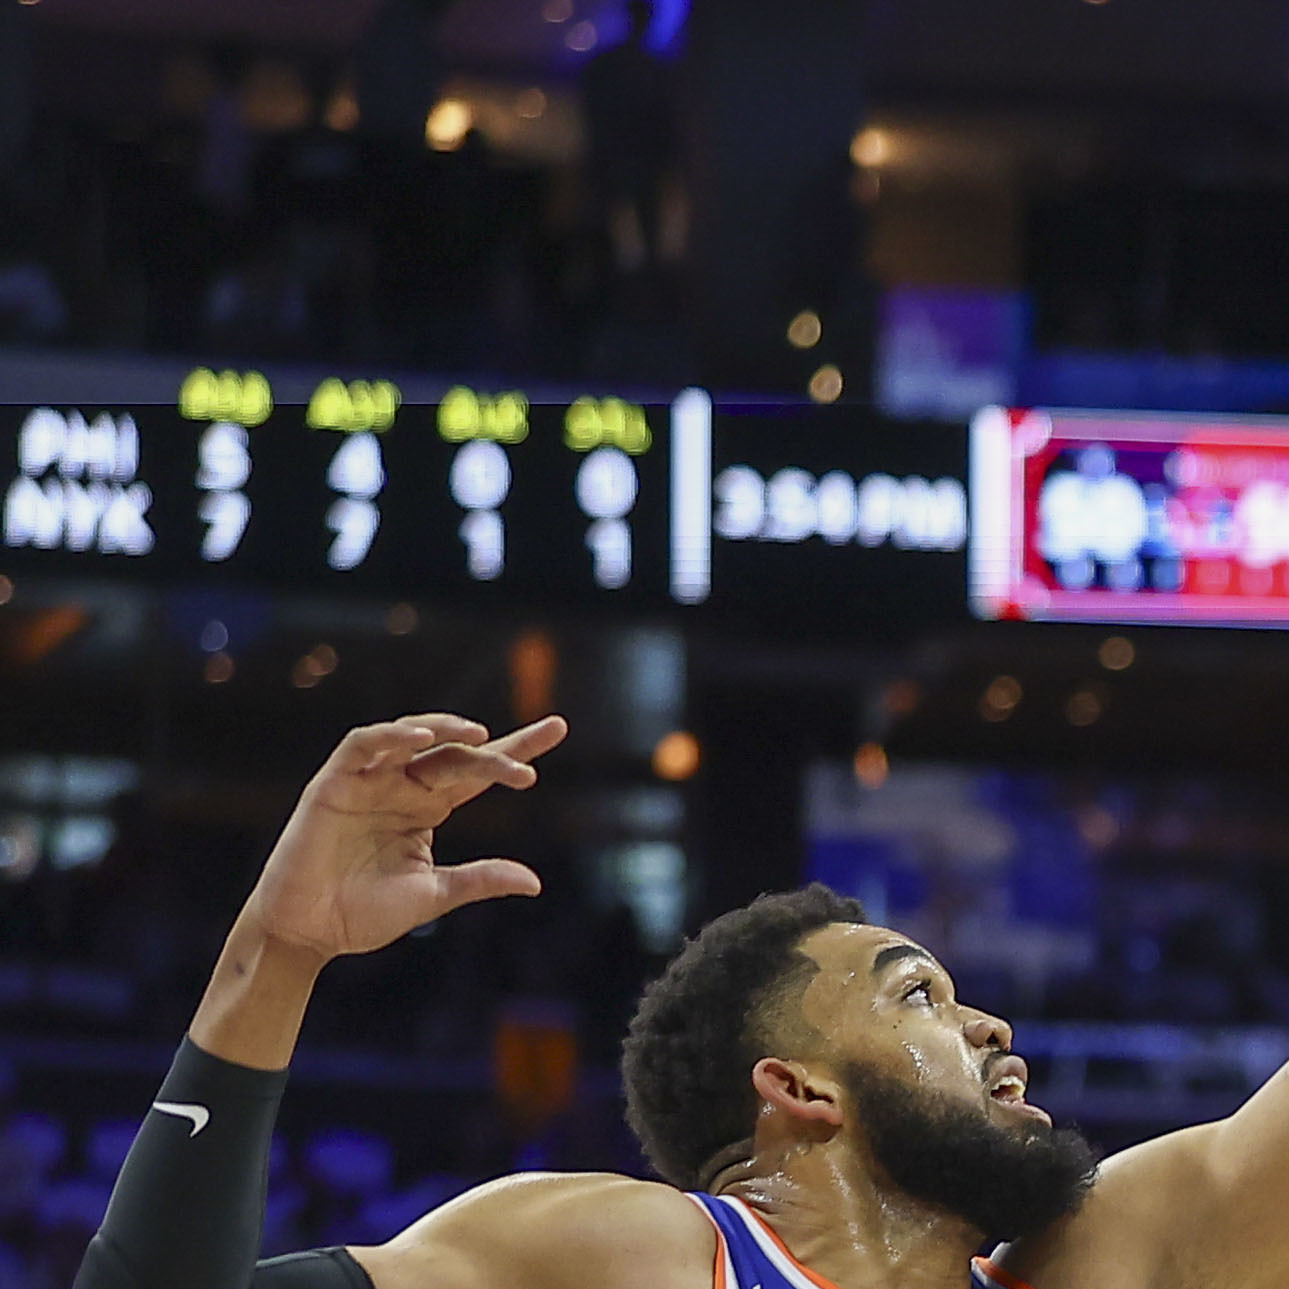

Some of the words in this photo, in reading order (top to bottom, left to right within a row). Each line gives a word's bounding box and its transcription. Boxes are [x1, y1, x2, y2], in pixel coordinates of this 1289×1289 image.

[18, 405, 140, 482] PHI
[194, 420, 252, 490] 5
[326, 430, 387, 500] 4
[449, 438, 513, 510] 0
[576, 446, 640, 519] 0
[4, 474, 155, 556] NYK
[199, 488, 252, 562] 7
[326, 496, 382, 571] 7
[459, 508, 505, 582] 1
[585, 516, 633, 590] 1
